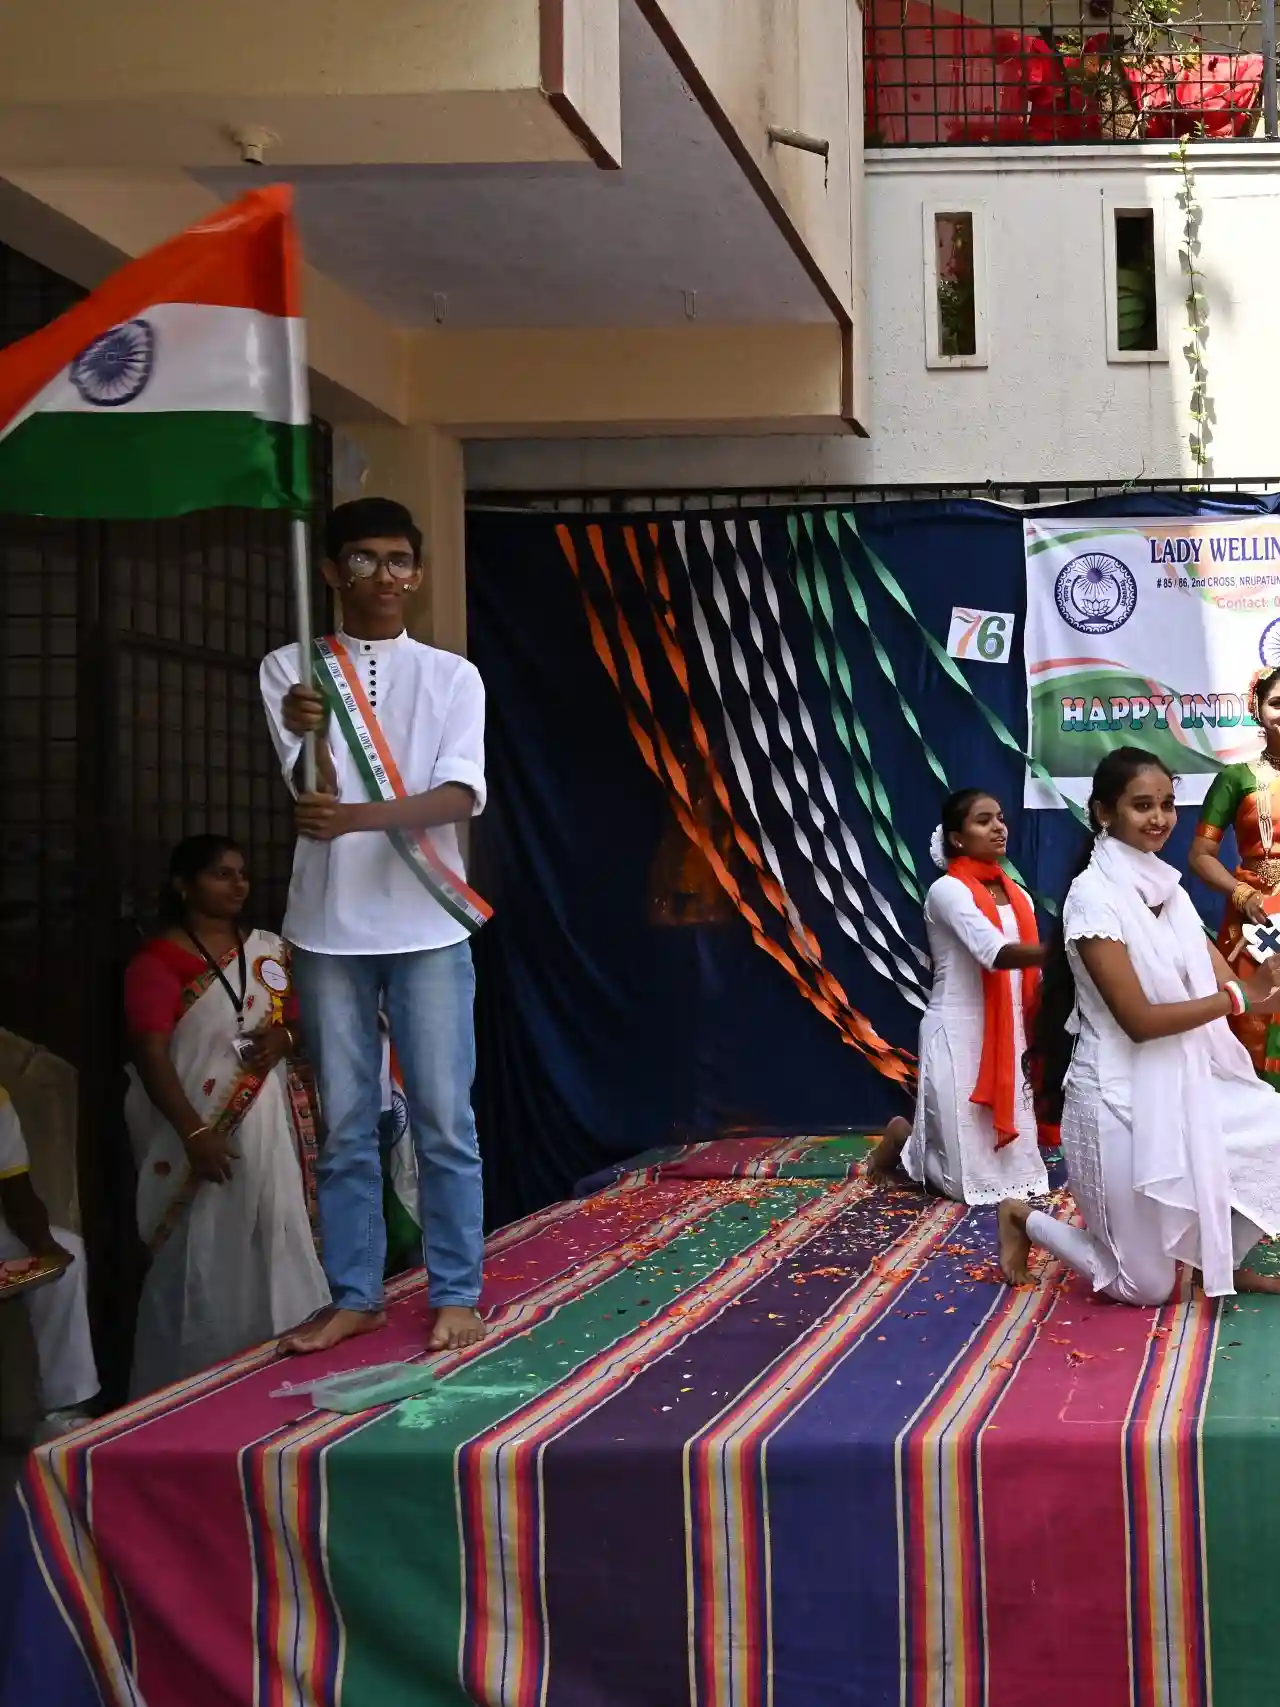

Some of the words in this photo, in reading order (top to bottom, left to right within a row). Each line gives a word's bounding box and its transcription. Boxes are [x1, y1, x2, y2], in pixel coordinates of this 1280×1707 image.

[1150, 538, 1202, 563] LADY
[1191, 577, 1206, 588] 2nd
[1207, 576, 1238, 588] CROSS,
[1216, 597, 1269, 609] Contact:
[954, 608, 1006, 660] 76
[342, 692, 357, 713] INDIA
[1061, 694, 1175, 732] HAPPY
[359, 732, 373, 750] LOVE
[373, 764, 388, 785] INDIA
